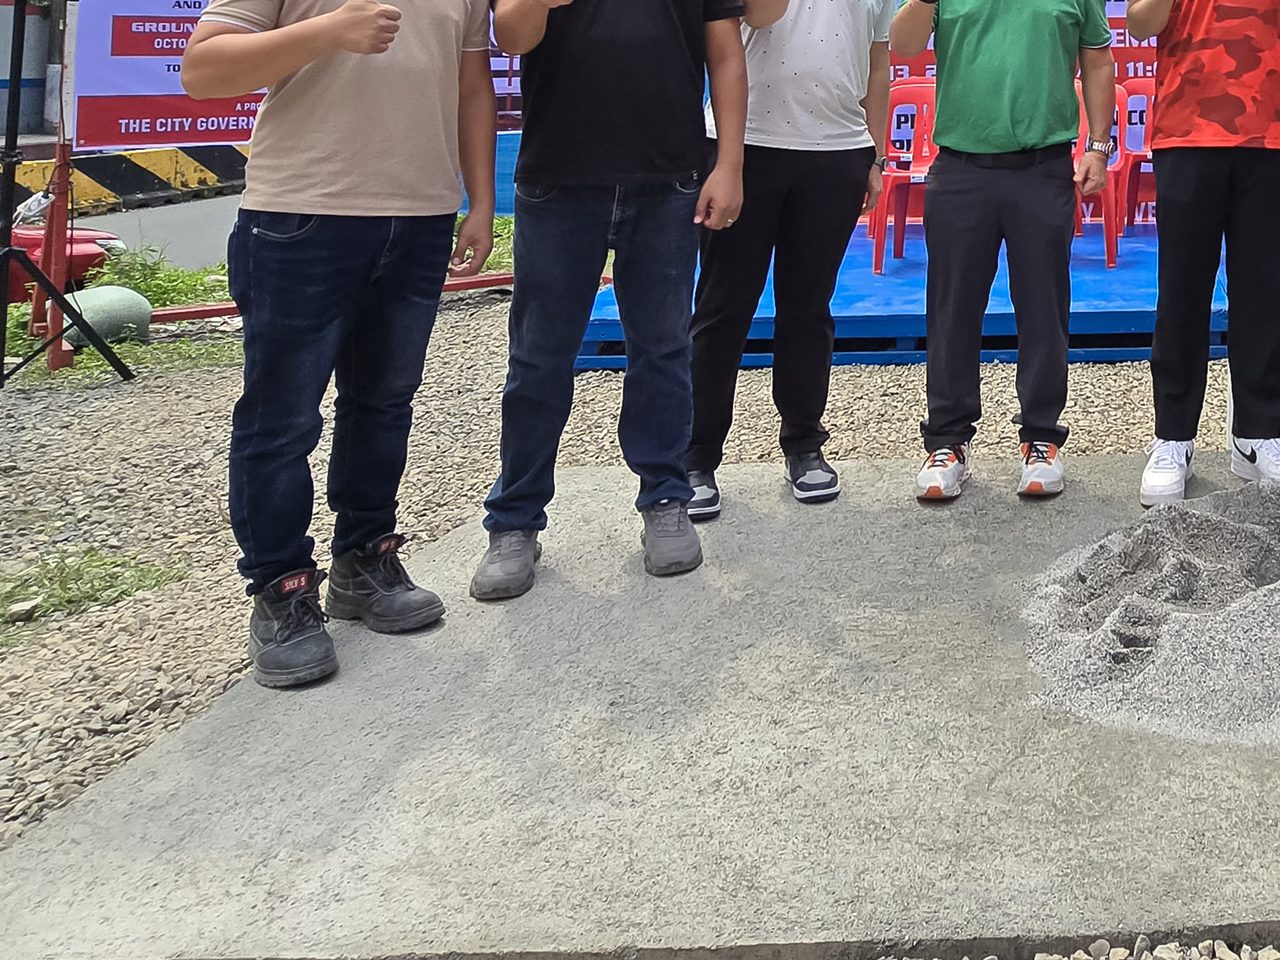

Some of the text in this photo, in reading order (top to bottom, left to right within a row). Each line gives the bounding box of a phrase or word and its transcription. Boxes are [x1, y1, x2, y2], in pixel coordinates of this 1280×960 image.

[172, 0, 202, 10] AND
[235, 102, 242, 111] A
[118, 119, 151, 133] THE
[156, 118, 192, 132] CITY
